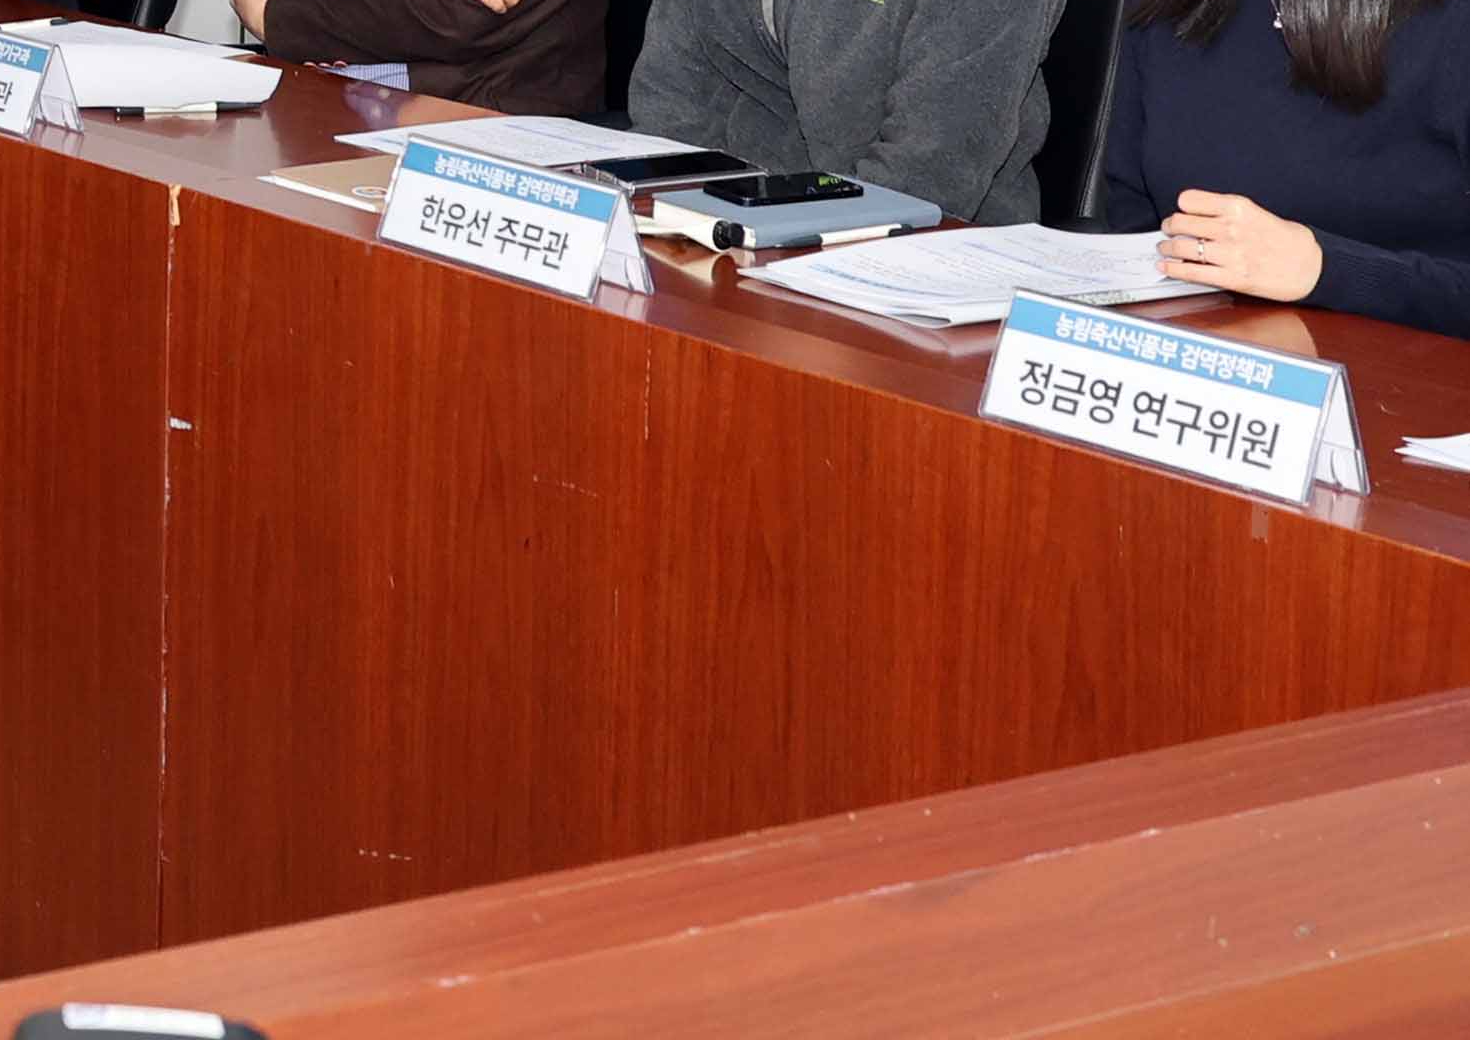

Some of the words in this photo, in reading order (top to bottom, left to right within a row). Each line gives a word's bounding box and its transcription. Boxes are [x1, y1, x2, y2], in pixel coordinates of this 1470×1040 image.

[434, 153, 517, 193] 농림축산식품부
[517, 176, 580, 211] 검역정책과
[420, 194, 492, 248] 한유선
[494, 216, 569, 270] 주무관
[1054, 312, 1179, 364] 농림축산식품부
[1181, 340, 1275, 390] 검역정책과
[1019, 359, 1124, 425] 정금영
[1132, 389, 1281, 470] 연구위원
